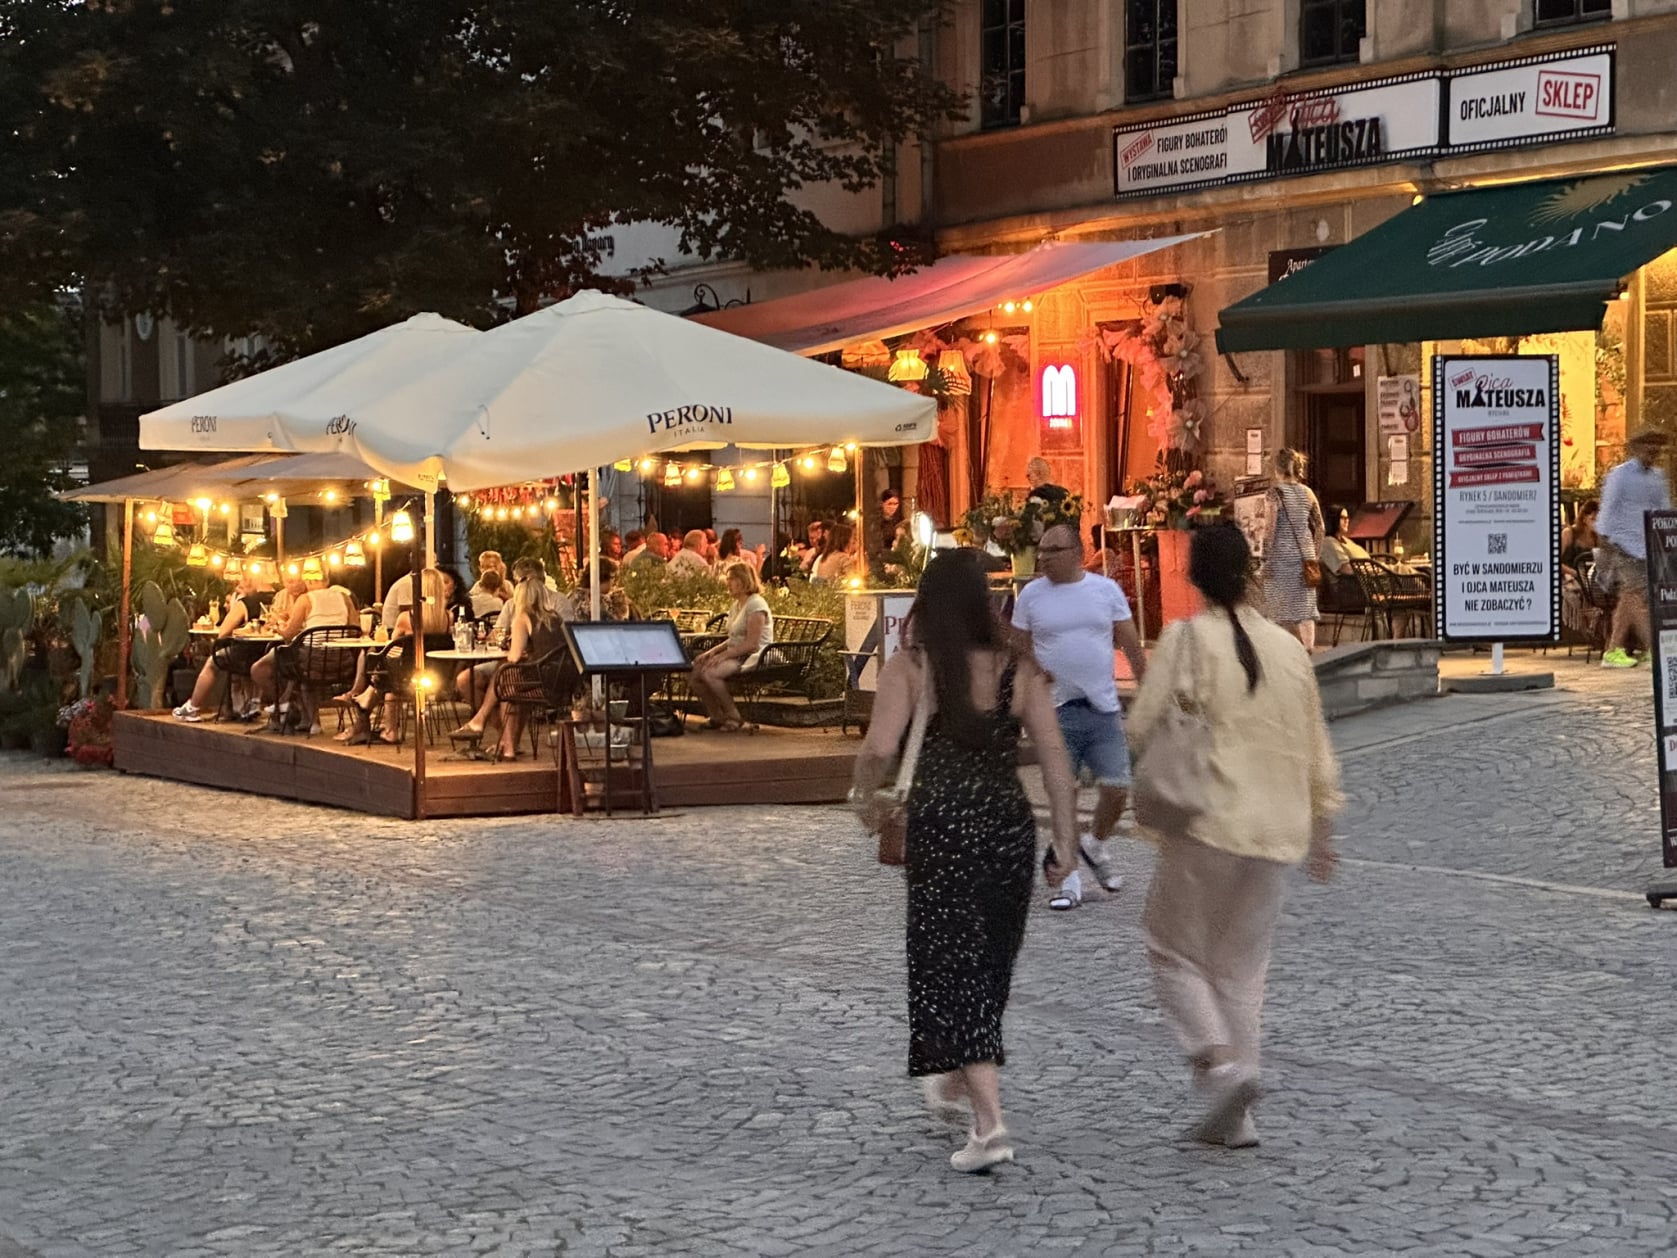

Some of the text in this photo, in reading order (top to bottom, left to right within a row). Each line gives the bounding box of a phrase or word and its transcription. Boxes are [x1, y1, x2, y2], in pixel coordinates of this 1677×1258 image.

[1460, 80, 1594, 121] OFICJALNY SKLEP
[1157, 124, 1228, 154] FIGURY BOHATERÓ
[1123, 133, 1153, 163] WYSTAWA
[1132, 160, 1179, 182] ORYGINALNA
[646, 403, 732, 434] PERONI
[674, 426, 705, 438] ITALIA
[1459, 426, 1530, 443] FIGURY BOHATERÓW
[1459, 491, 1481, 502] RYNEK
[1494, 489, 1537, 501] SANDOMIERZ
[1453, 561, 1543, 575] BYĆ W SANDOMIERZU
[1467, 581, 1487, 593] OJCA
[1489, 580, 1535, 593] MATEUSZA
[1464, 599, 1479, 611] NIE
[1480, 596, 1525, 611] ZOBACZYĆ
